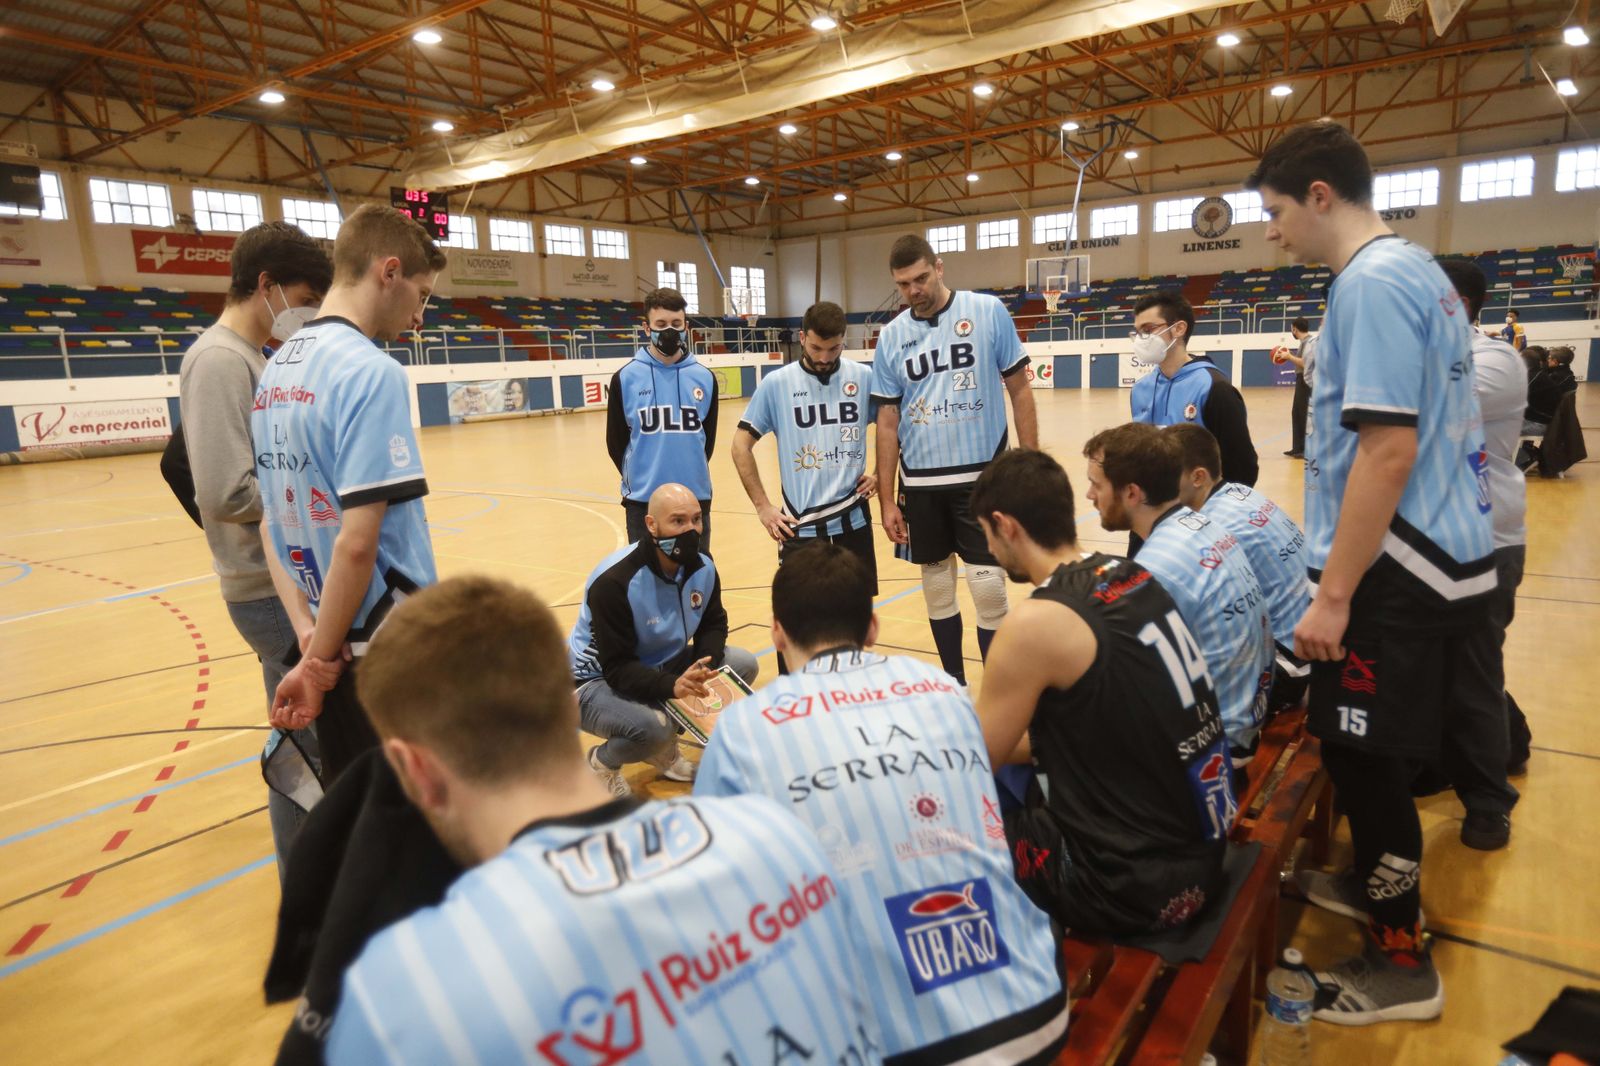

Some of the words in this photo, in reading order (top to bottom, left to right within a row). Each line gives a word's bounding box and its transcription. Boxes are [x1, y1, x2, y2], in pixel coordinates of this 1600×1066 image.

[1082, 237, 1120, 249] UNION
[1183, 239, 1241, 253] LINENSE
[904, 341, 977, 383] ULB
[952, 370, 978, 392] 21
[69, 416, 167, 436] empresarial
[637, 404, 704, 435] ULB
[793, 401, 860, 430] ULB
[841, 426, 860, 443] 20
[1136, 608, 1215, 709] 14
[830, 687, 888, 705] Ruiz
[890, 679, 960, 697] Galán
[1336, 705, 1368, 737] 15
[855, 724, 919, 748] LA
[788, 749, 990, 804] SERRANA
[543, 800, 714, 899] ULB
[659, 933, 753, 1002] Ruiz
[748, 873, 837, 944] Galán
